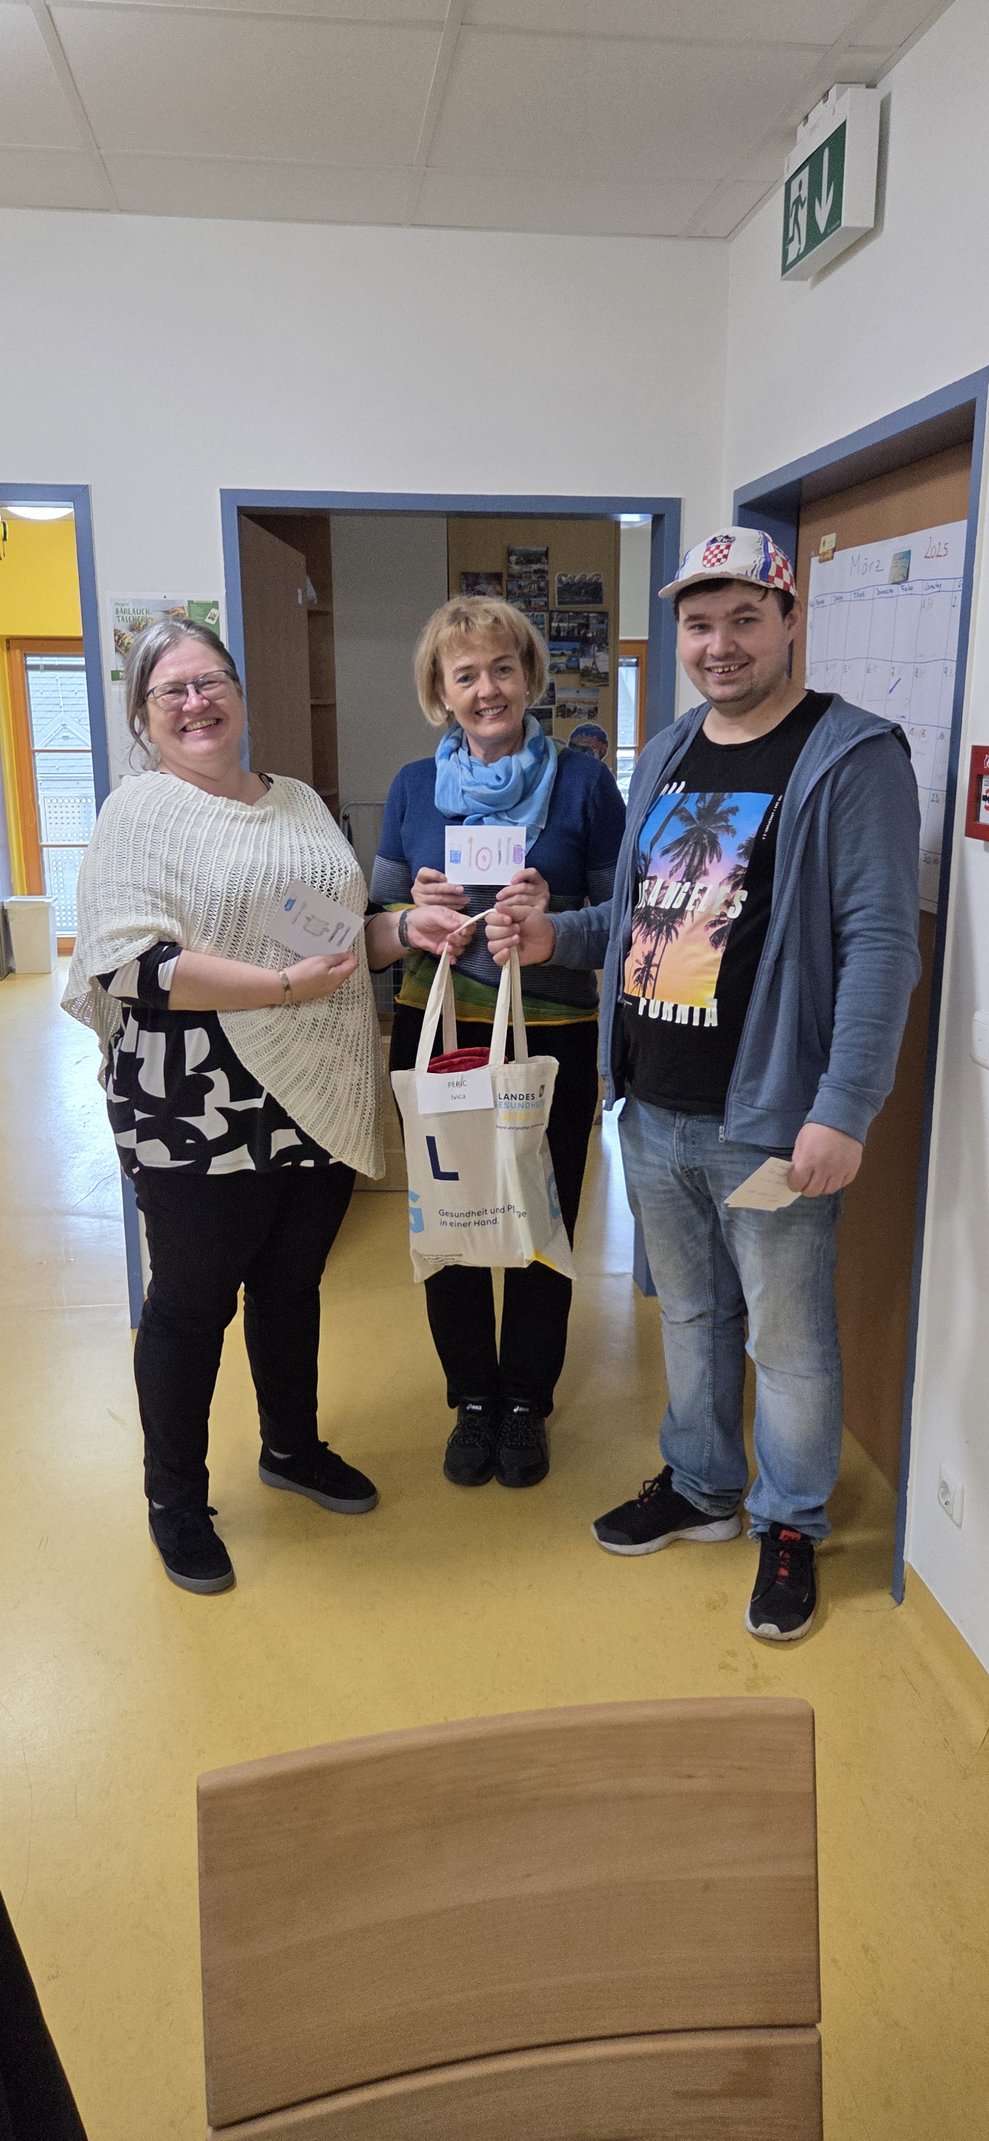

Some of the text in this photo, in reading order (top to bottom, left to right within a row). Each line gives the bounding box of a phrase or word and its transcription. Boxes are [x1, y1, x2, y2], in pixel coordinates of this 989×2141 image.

[923, 536, 949, 559] 2025
[498, 1093, 536, 1101] LANDES
[438, 1208, 488, 1218] Gesundheit
[490, 1206, 505, 1215] und
[439, 1217, 500, 1228] in einer Hand.
